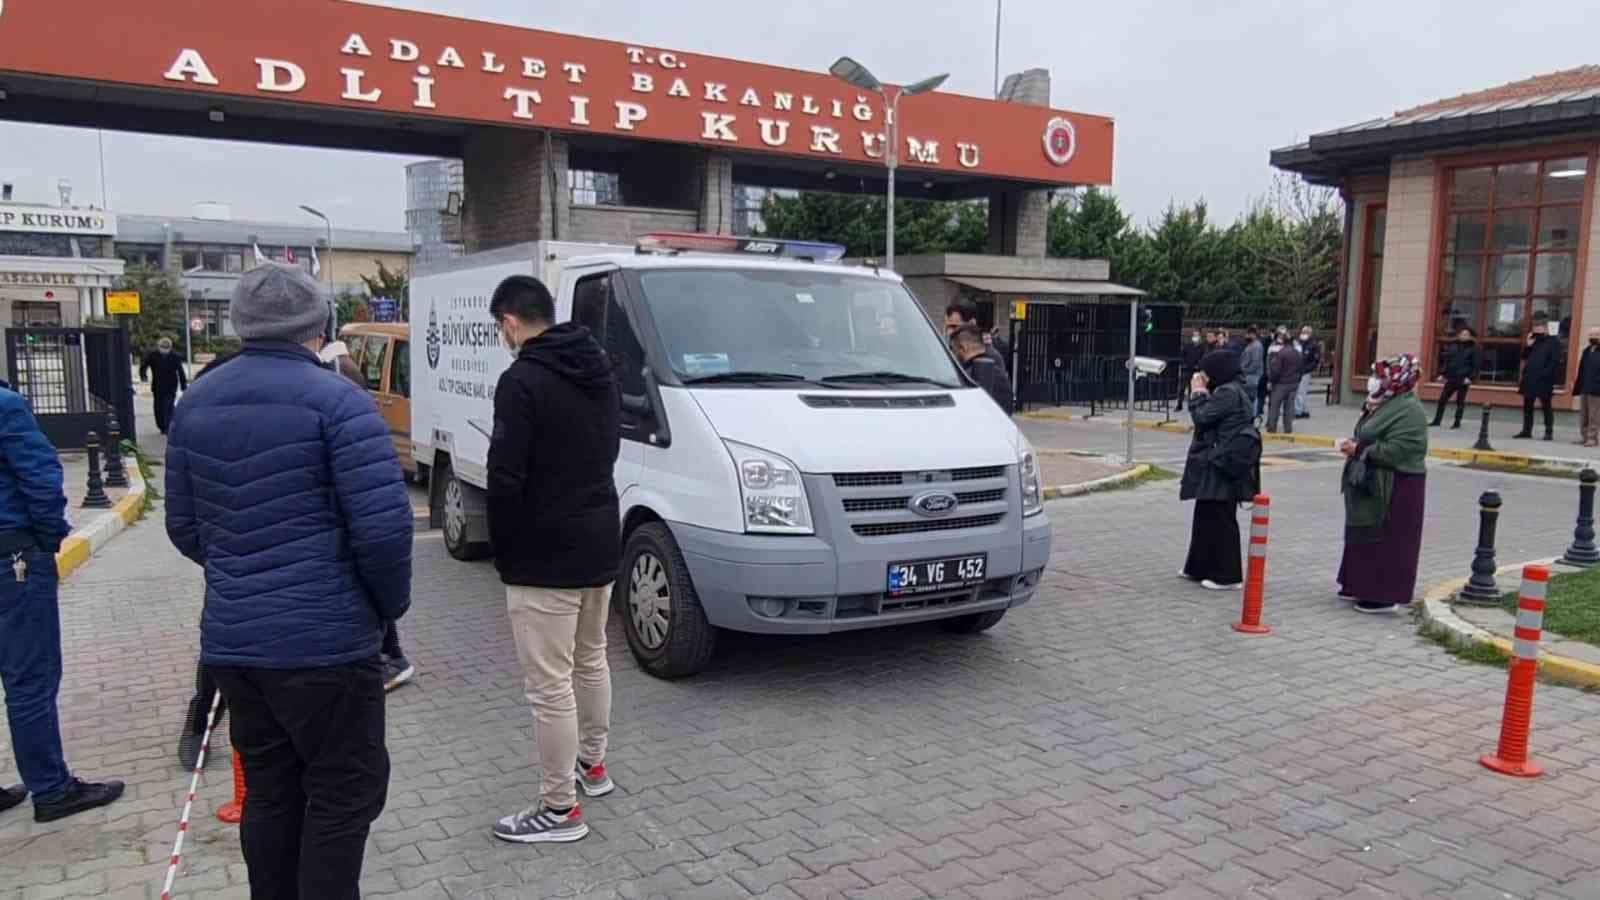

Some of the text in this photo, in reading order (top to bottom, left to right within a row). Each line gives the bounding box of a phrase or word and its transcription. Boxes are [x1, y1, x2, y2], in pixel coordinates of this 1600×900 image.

[627, 46, 687, 69] T.C.
[340, 33, 896, 125] ADALET BAKANLIĞI
[163, 48, 981, 167] ADLİ TIP KURUMU
[925, 496, 949, 510] Ford
[899, 558, 983, 586] 34 VG 452
